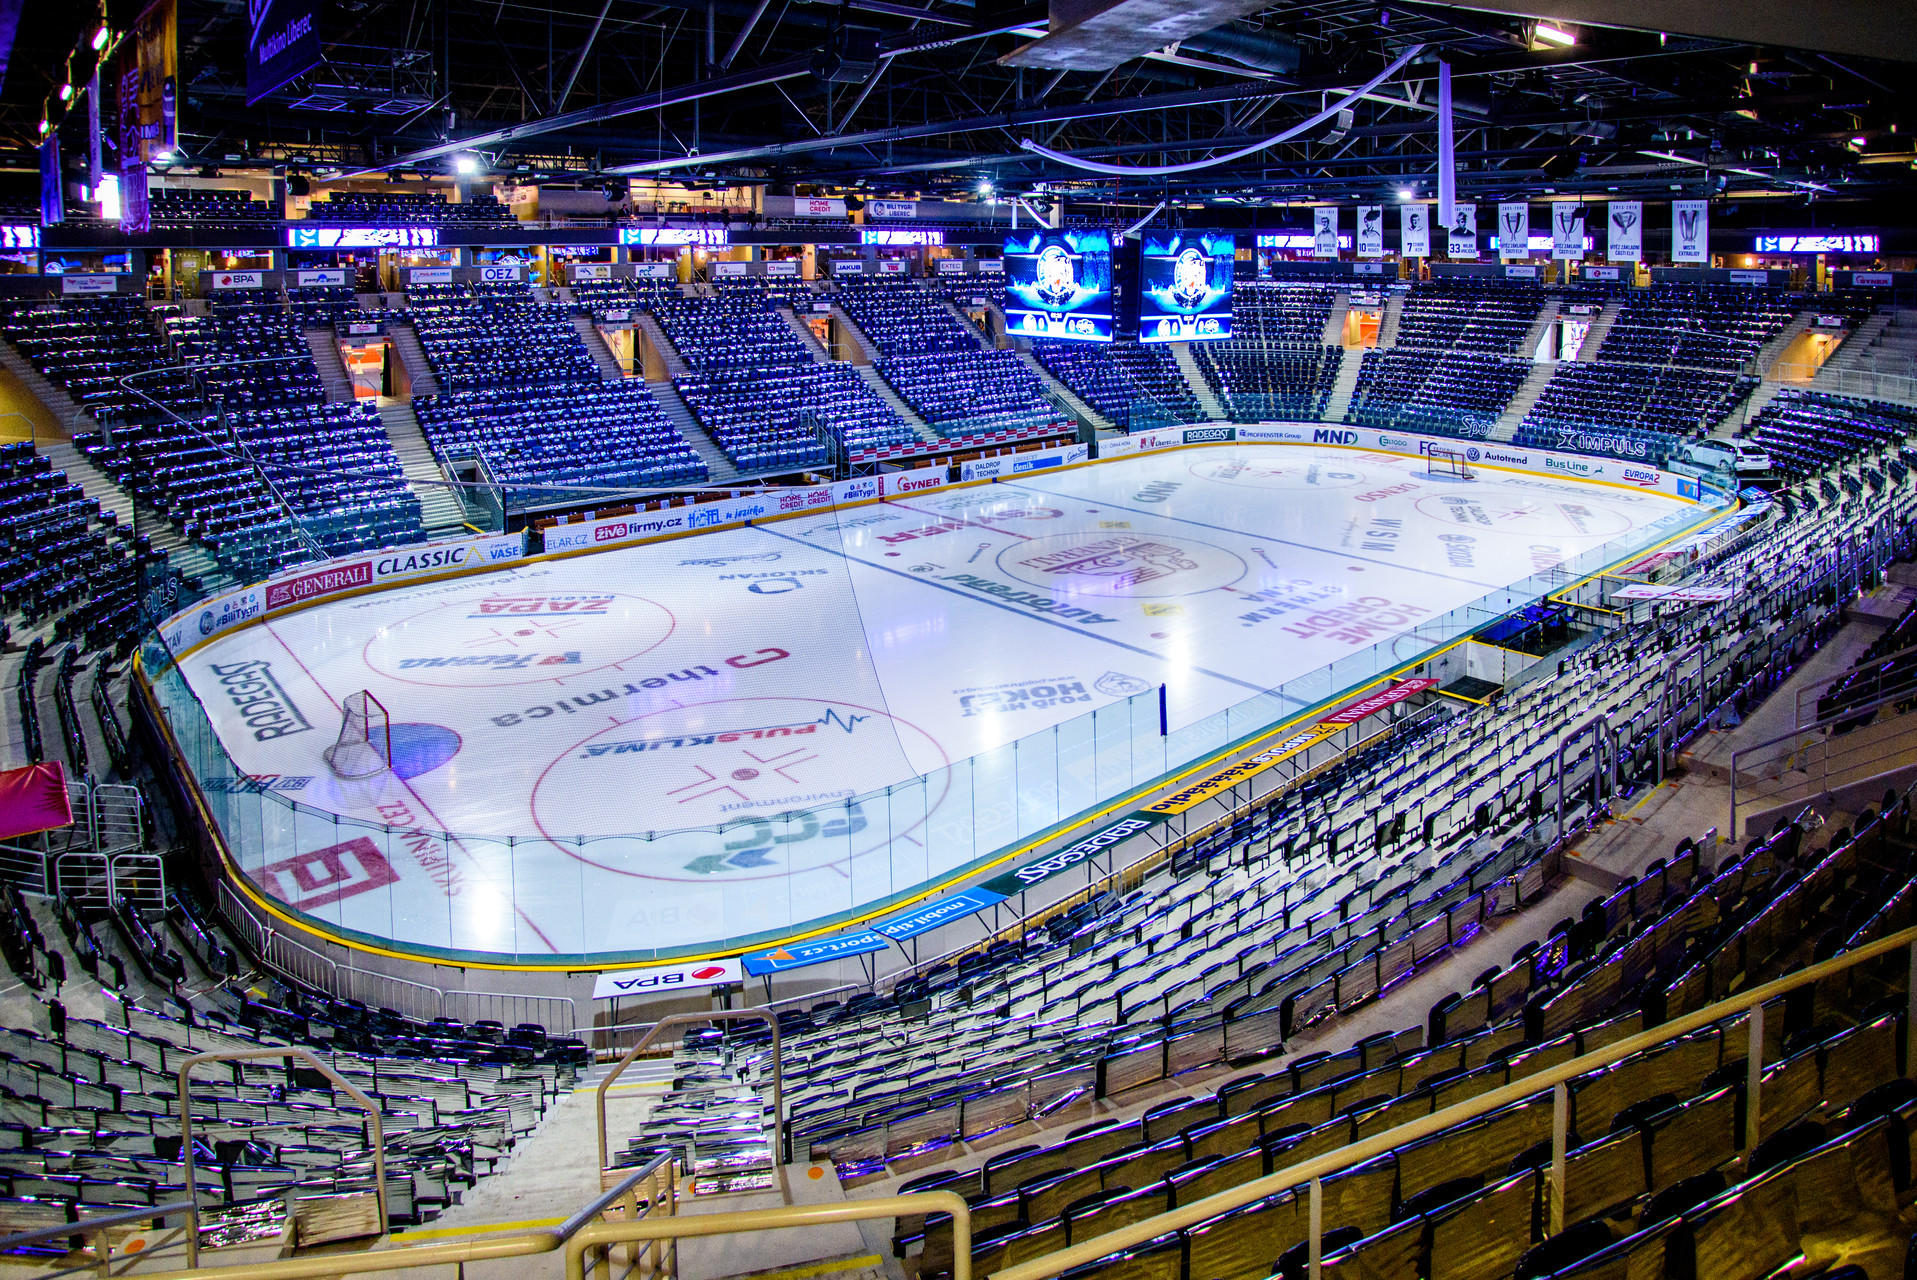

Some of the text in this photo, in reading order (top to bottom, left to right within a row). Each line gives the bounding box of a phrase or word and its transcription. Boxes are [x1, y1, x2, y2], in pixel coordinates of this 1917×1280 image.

[287, 12, 312, 46] Liberec
[1359, 243, 1366, 252] 10
[1407, 243, 1412, 252] 7
[1450, 244, 1460, 253] 33
[233, 275, 254, 284] BPA
[485, 268, 513, 280] OEZ
[1187, 428, 1229, 441] RADEGAST
[1313, 429, 1358, 445] MND
[1420, 440, 1438, 456] FC
[1579, 435, 1646, 456] IMPULS
[975, 461, 1000, 470] DALDROP
[1485, 452, 1528, 464] Autotrend
[1546, 458, 1588, 472] Bus Line
[977, 469, 1000, 477] TECHNIK
[1624, 469, 1660, 483] EVROPA 2
[903, 478, 940, 491] SYNER
[1355, 483, 1420, 502] DENSO
[780, 494, 801, 503] HOME
[808, 489, 828, 499] HOME
[808, 496, 831, 505] CREDIT
[780, 500, 804, 510] CREDIT
[629, 517, 682, 534] firmy.cz
[377, 547, 465, 576] CLASSIC
[292, 565, 368, 598] GENERALI
[480, 600, 614, 614] ZAPA
[942, 573, 1120, 626] Autotrend
[1280, 596, 1391, 640] CREDIT
[1325, 603, 1432, 646] HOME
[209, 659, 301, 742] RADEGAST
[490, 663, 719, 728] thermica
[1329, 687, 1410, 722] GENERALI
[584, 723, 816, 757] PULSKLIMA
[1249, 731, 1316, 764] IMPULS
[720, 789, 857, 812] Environment
[1015, 817, 1152, 883] RADEGAST
[612, 972, 685, 990] BPA
